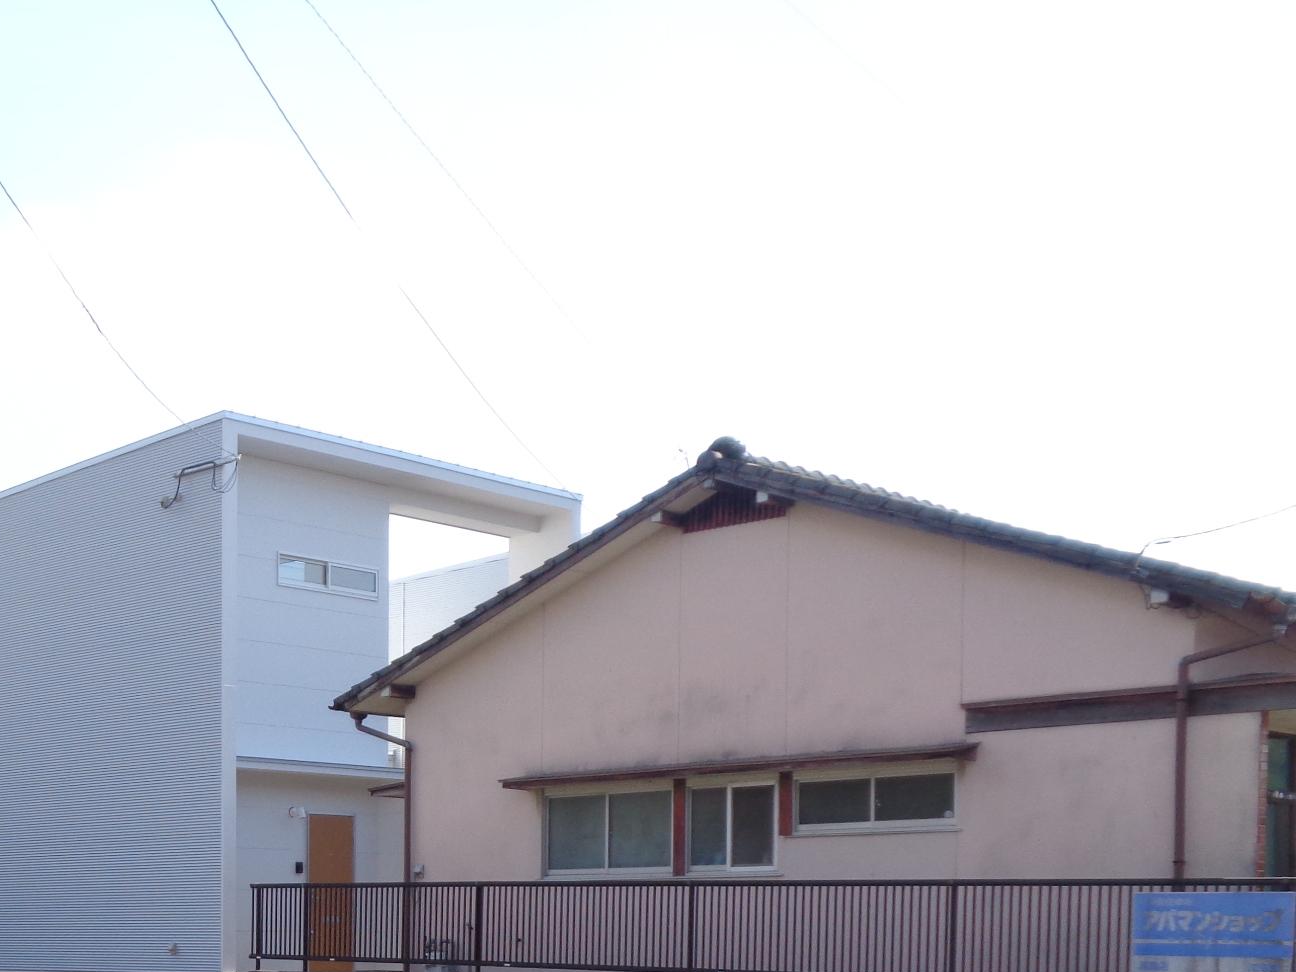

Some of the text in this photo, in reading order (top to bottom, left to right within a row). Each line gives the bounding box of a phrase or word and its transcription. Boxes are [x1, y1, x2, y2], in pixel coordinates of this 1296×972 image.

[1145, 909, 1283, 932] アパマンショップ
